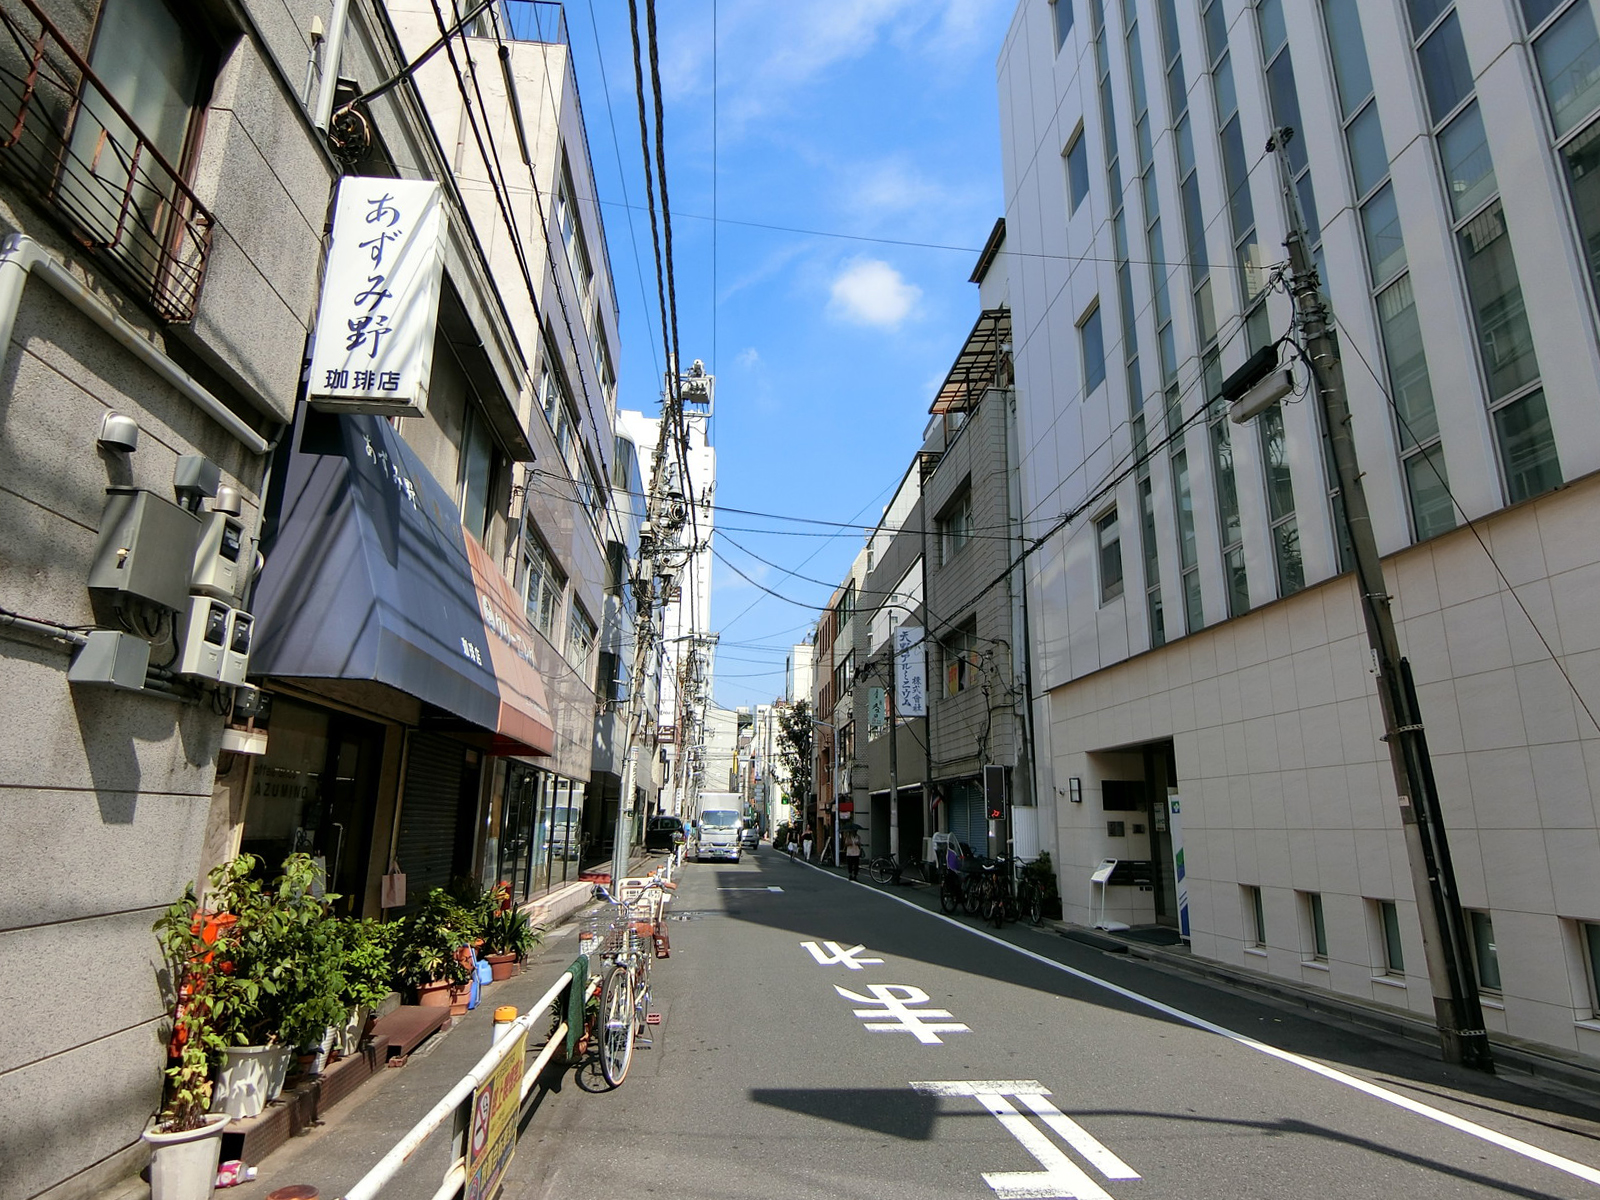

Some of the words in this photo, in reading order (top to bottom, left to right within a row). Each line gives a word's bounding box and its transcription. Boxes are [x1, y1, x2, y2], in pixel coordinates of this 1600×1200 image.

[345, 192, 403, 359] あずみ野
[324, 369, 401, 391] 珈琲店
[254, 782, 308, 798] AZUMINO
